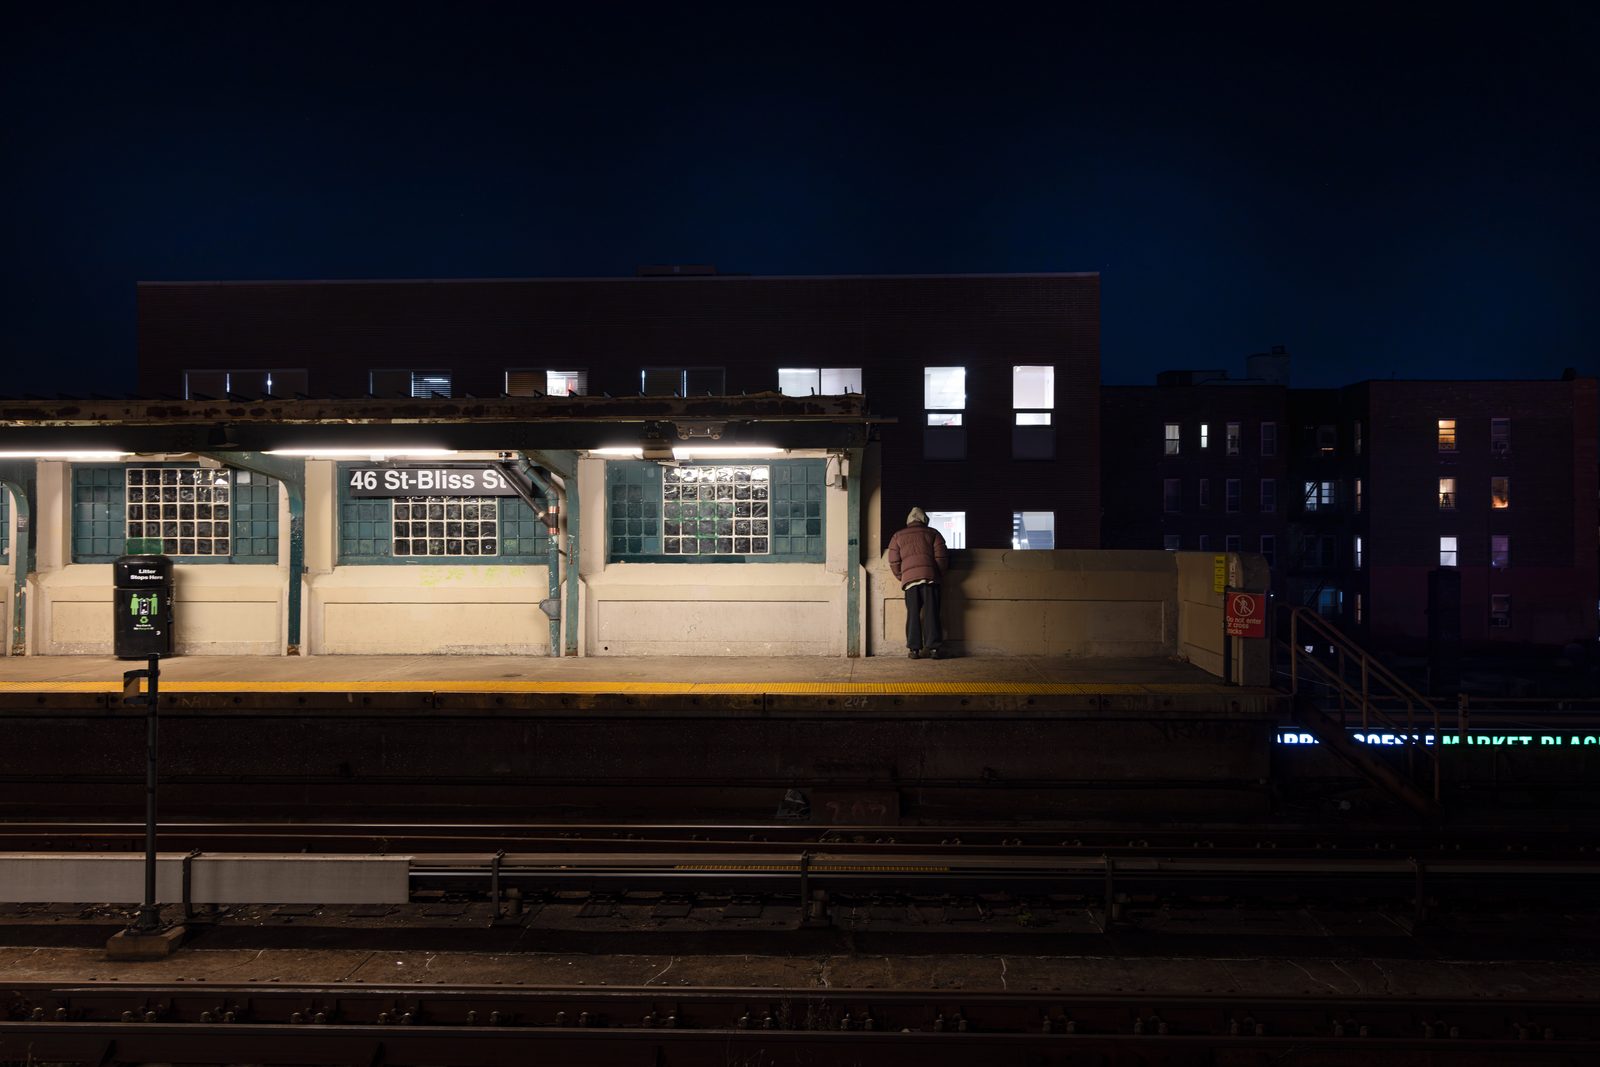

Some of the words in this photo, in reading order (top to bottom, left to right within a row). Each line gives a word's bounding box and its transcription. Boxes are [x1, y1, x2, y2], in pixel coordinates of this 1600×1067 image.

[350, 471, 377, 490] 46
[384, 470, 475, 490] St-Bliss
[482, 469, 507, 489] St
